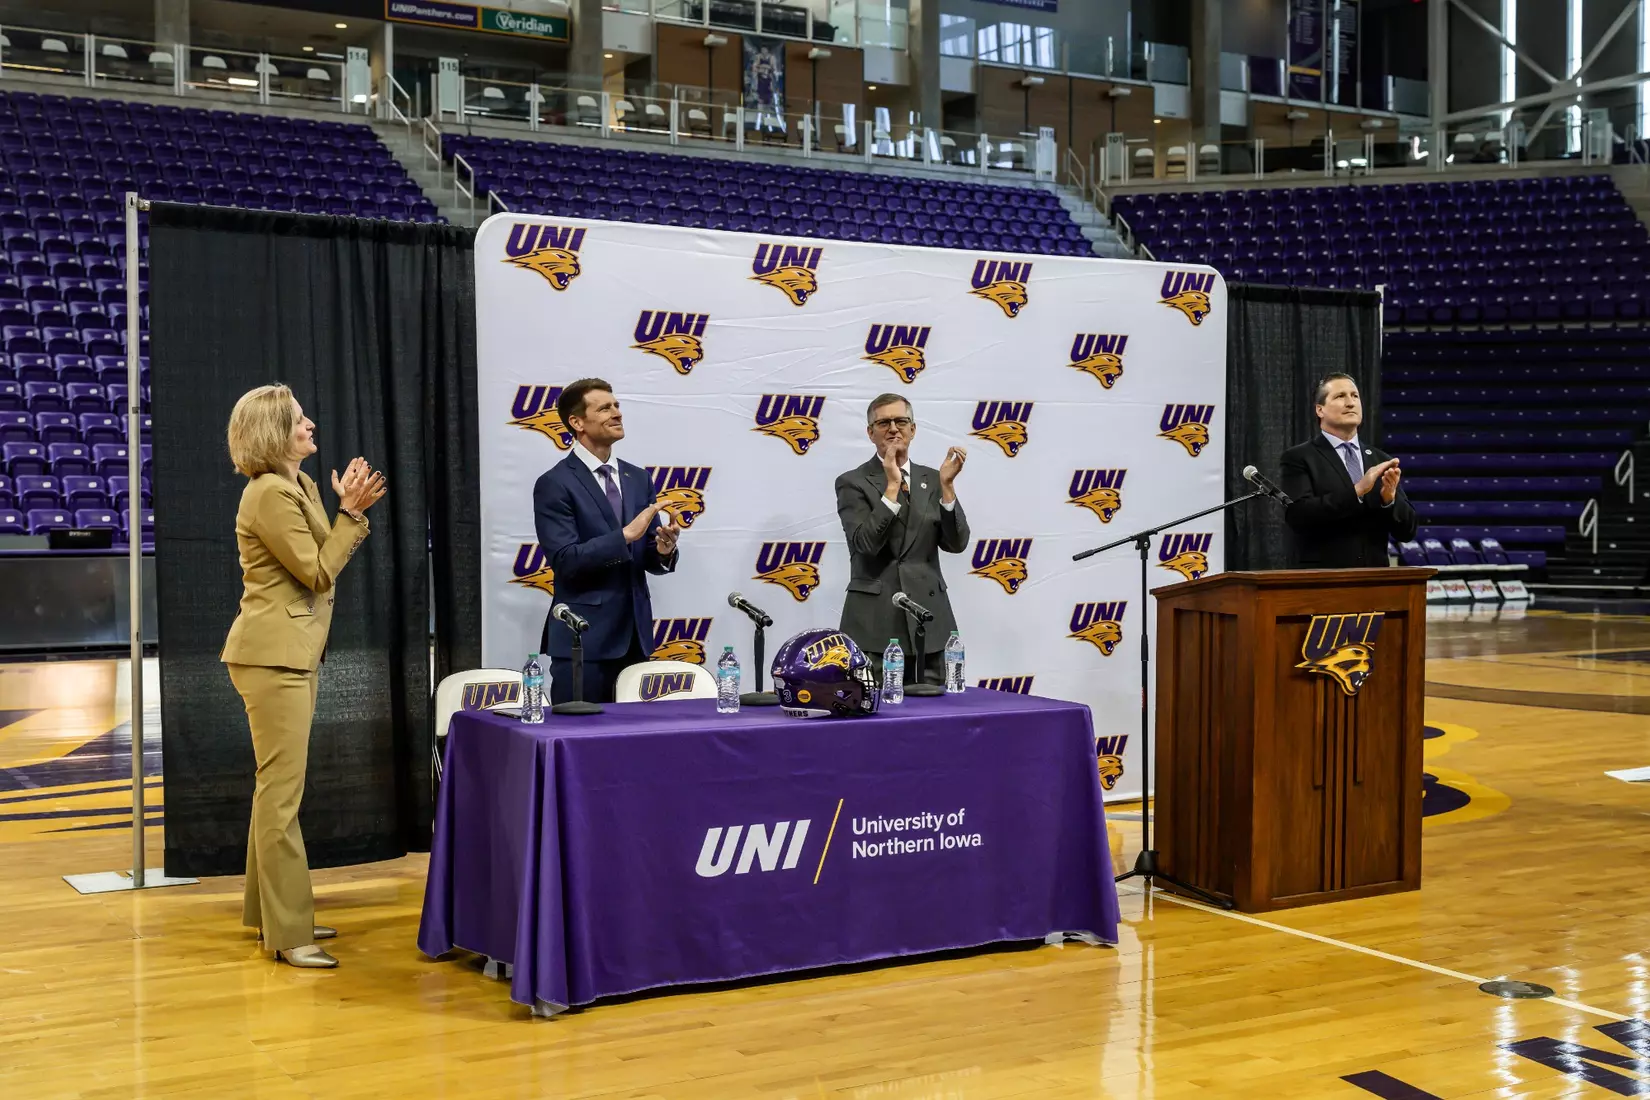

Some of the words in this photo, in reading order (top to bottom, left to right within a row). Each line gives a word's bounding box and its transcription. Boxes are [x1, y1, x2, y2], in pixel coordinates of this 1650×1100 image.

[391, 3, 474, 21] UNIPanthers.com
[498, 13, 552, 33] Veridian
[440, 61, 458, 72] 115
[505, 223, 587, 257] UNI
[752, 243, 824, 275] UNI
[971, 259, 1033, 290] UNI
[1160, 271, 1216, 299] UNI
[633, 310, 710, 343] UNI
[865, 323, 931, 354] UNI
[1070, 333, 1129, 363] UNI
[756, 394, 826, 425] UNI
[971, 401, 1034, 431] UNI
[1160, 403, 1216, 431] UNI
[1069, 469, 1127, 498] UNI
[756, 541, 827, 574] UNI
[971, 537, 1034, 568] UNI
[1158, 533, 1214, 562] UNI
[1070, 601, 1128, 633] UNI
[806, 634, 846, 666] UNI
[1302, 611, 1385, 660] UNI
[461, 681, 521, 711] UNI
[639, 672, 695, 702] UNI
[782, 689, 793, 703] 3
[852, 811, 944, 835] University
[946, 808, 965, 826] of
[695, 819, 811, 877] UNI
[852, 836, 934, 859] Northern
[939, 831, 982, 851] Iowa
